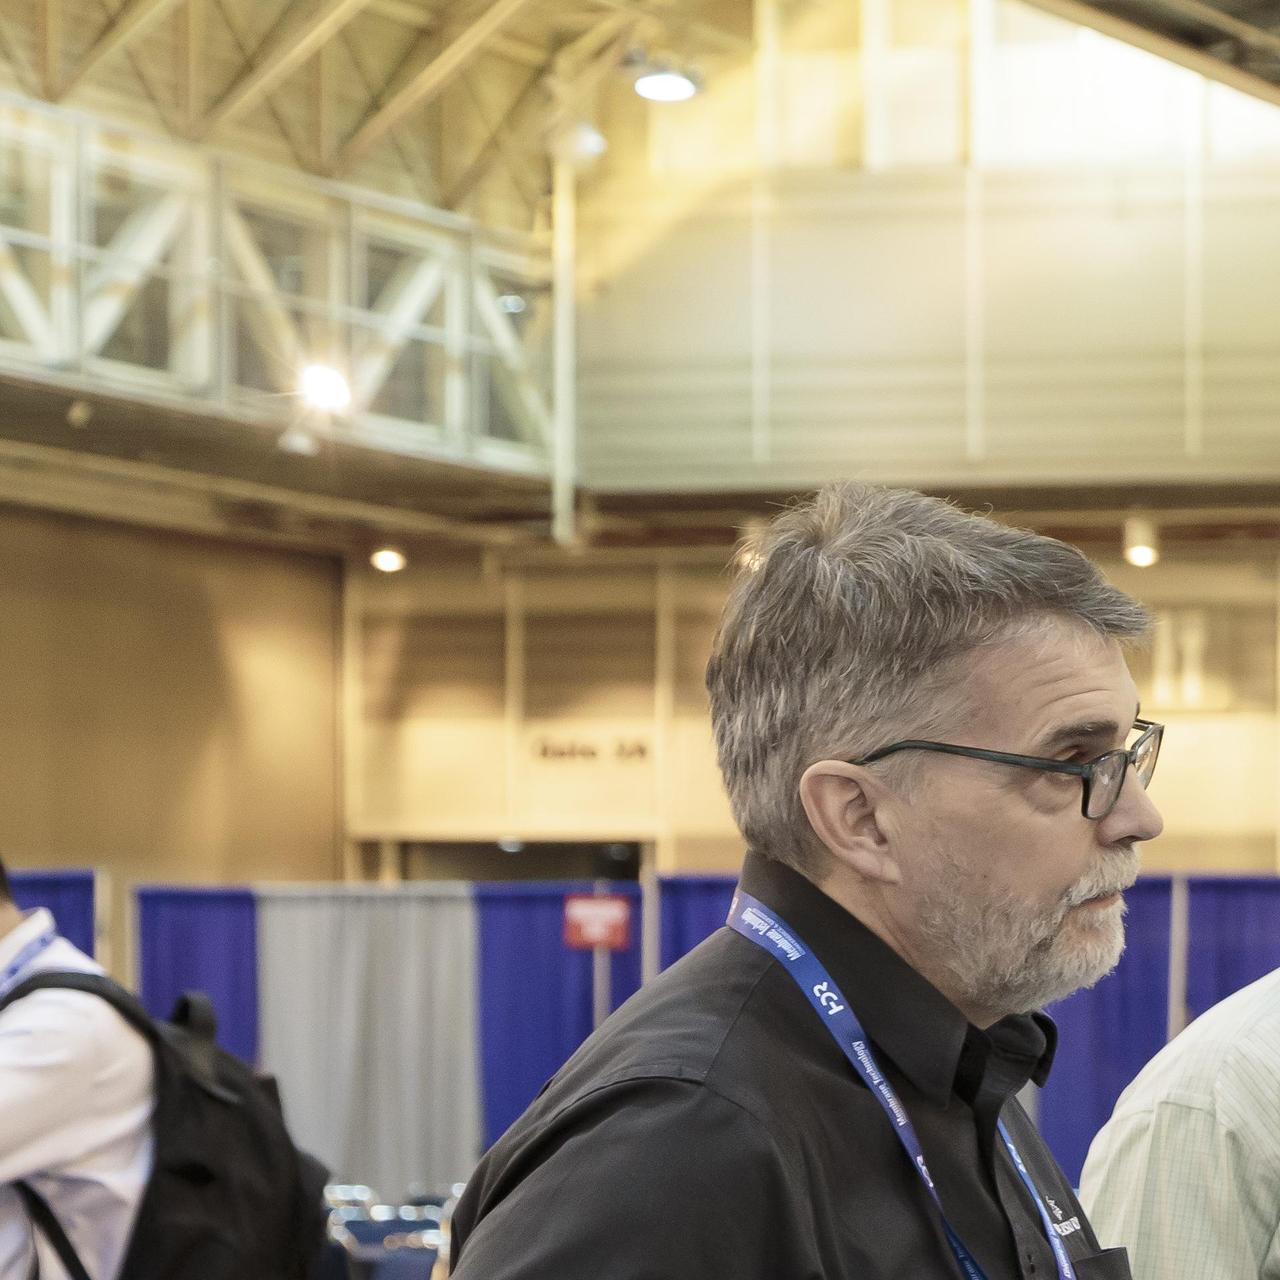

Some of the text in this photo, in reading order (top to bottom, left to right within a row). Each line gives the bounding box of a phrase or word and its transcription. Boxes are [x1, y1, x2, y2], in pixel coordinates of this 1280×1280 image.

[765, 929, 802, 961] Membrane
[851, 1039, 909, 1127] Membrane Technology
